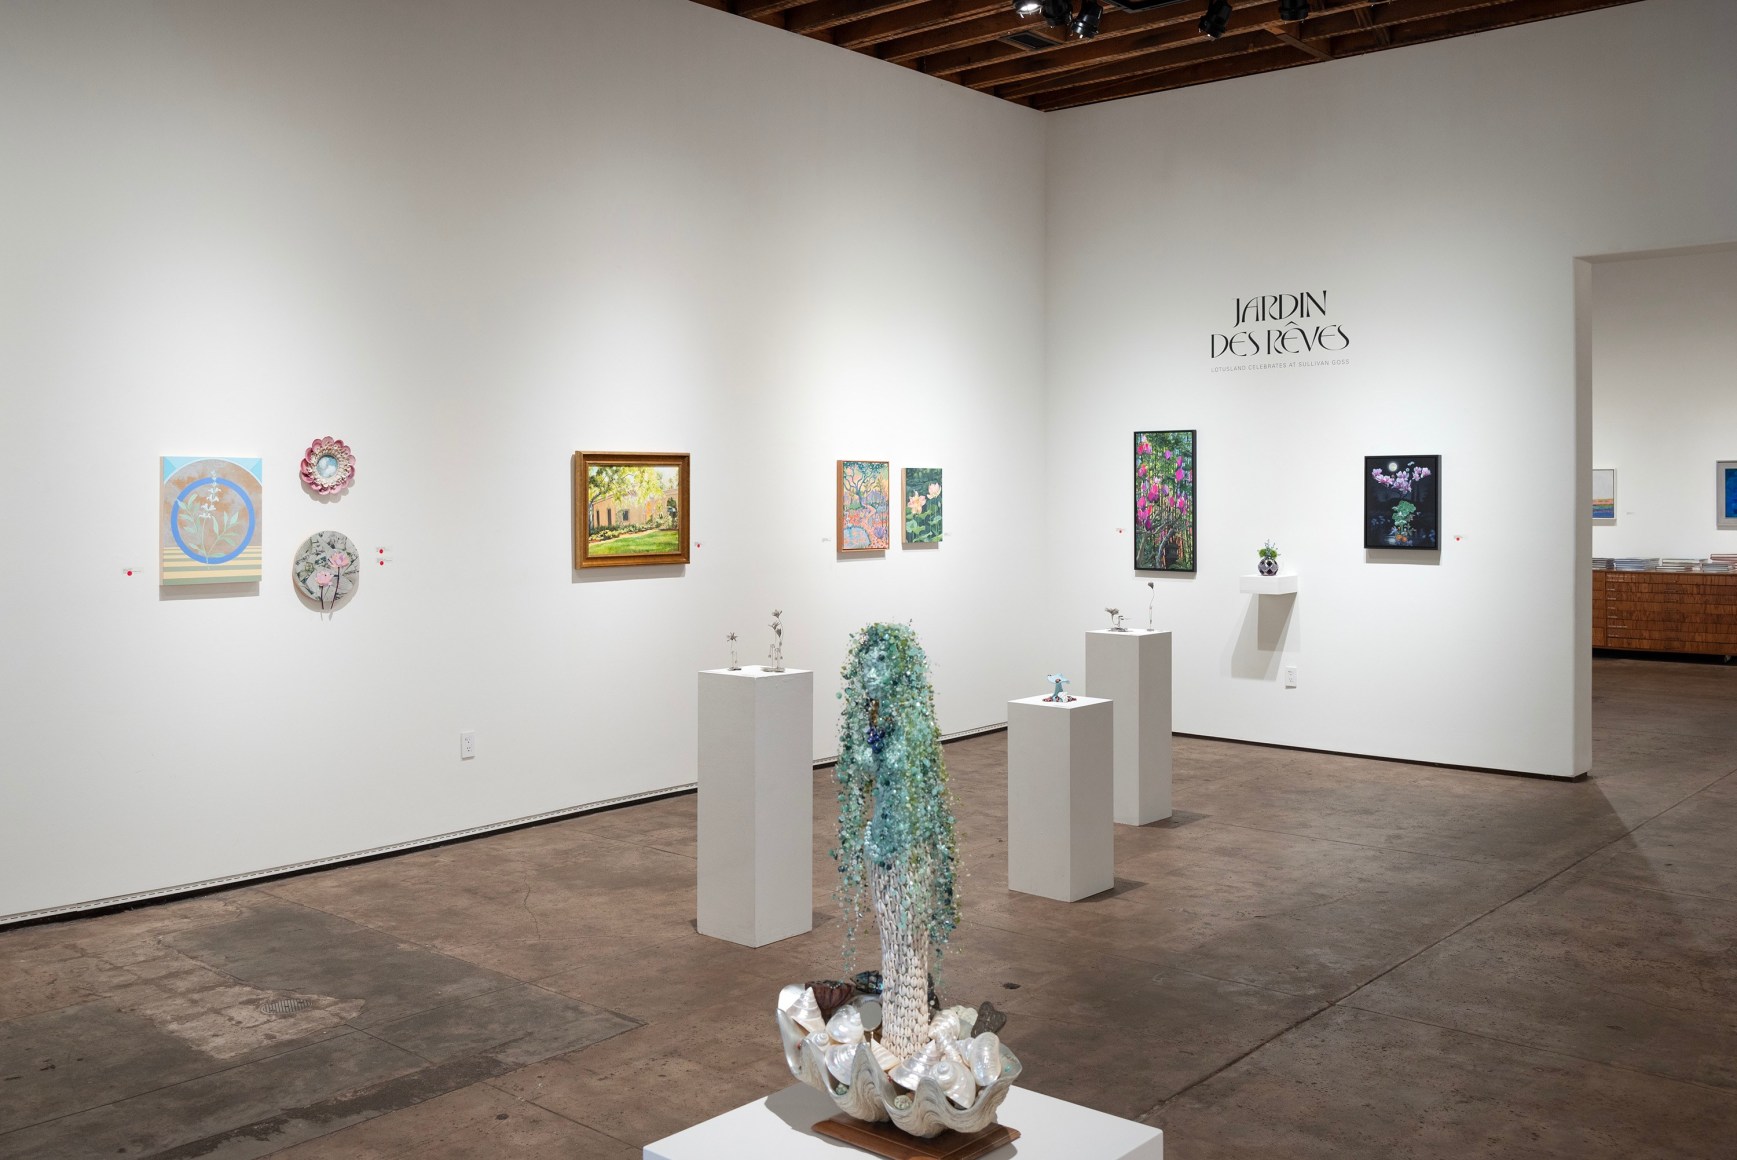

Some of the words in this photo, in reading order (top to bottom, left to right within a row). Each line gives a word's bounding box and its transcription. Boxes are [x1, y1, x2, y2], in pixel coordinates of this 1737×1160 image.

[1232, 290, 1327, 328] JARDIN
[1211, 331, 1260, 358] DES
[1267, 321, 1350, 355] RÊVES
[1210, 365, 1246, 373] LOTUSLAND
[1248, 362, 1287, 371] CELEBRATES
[1298, 360, 1330, 368] SULLIVAN
